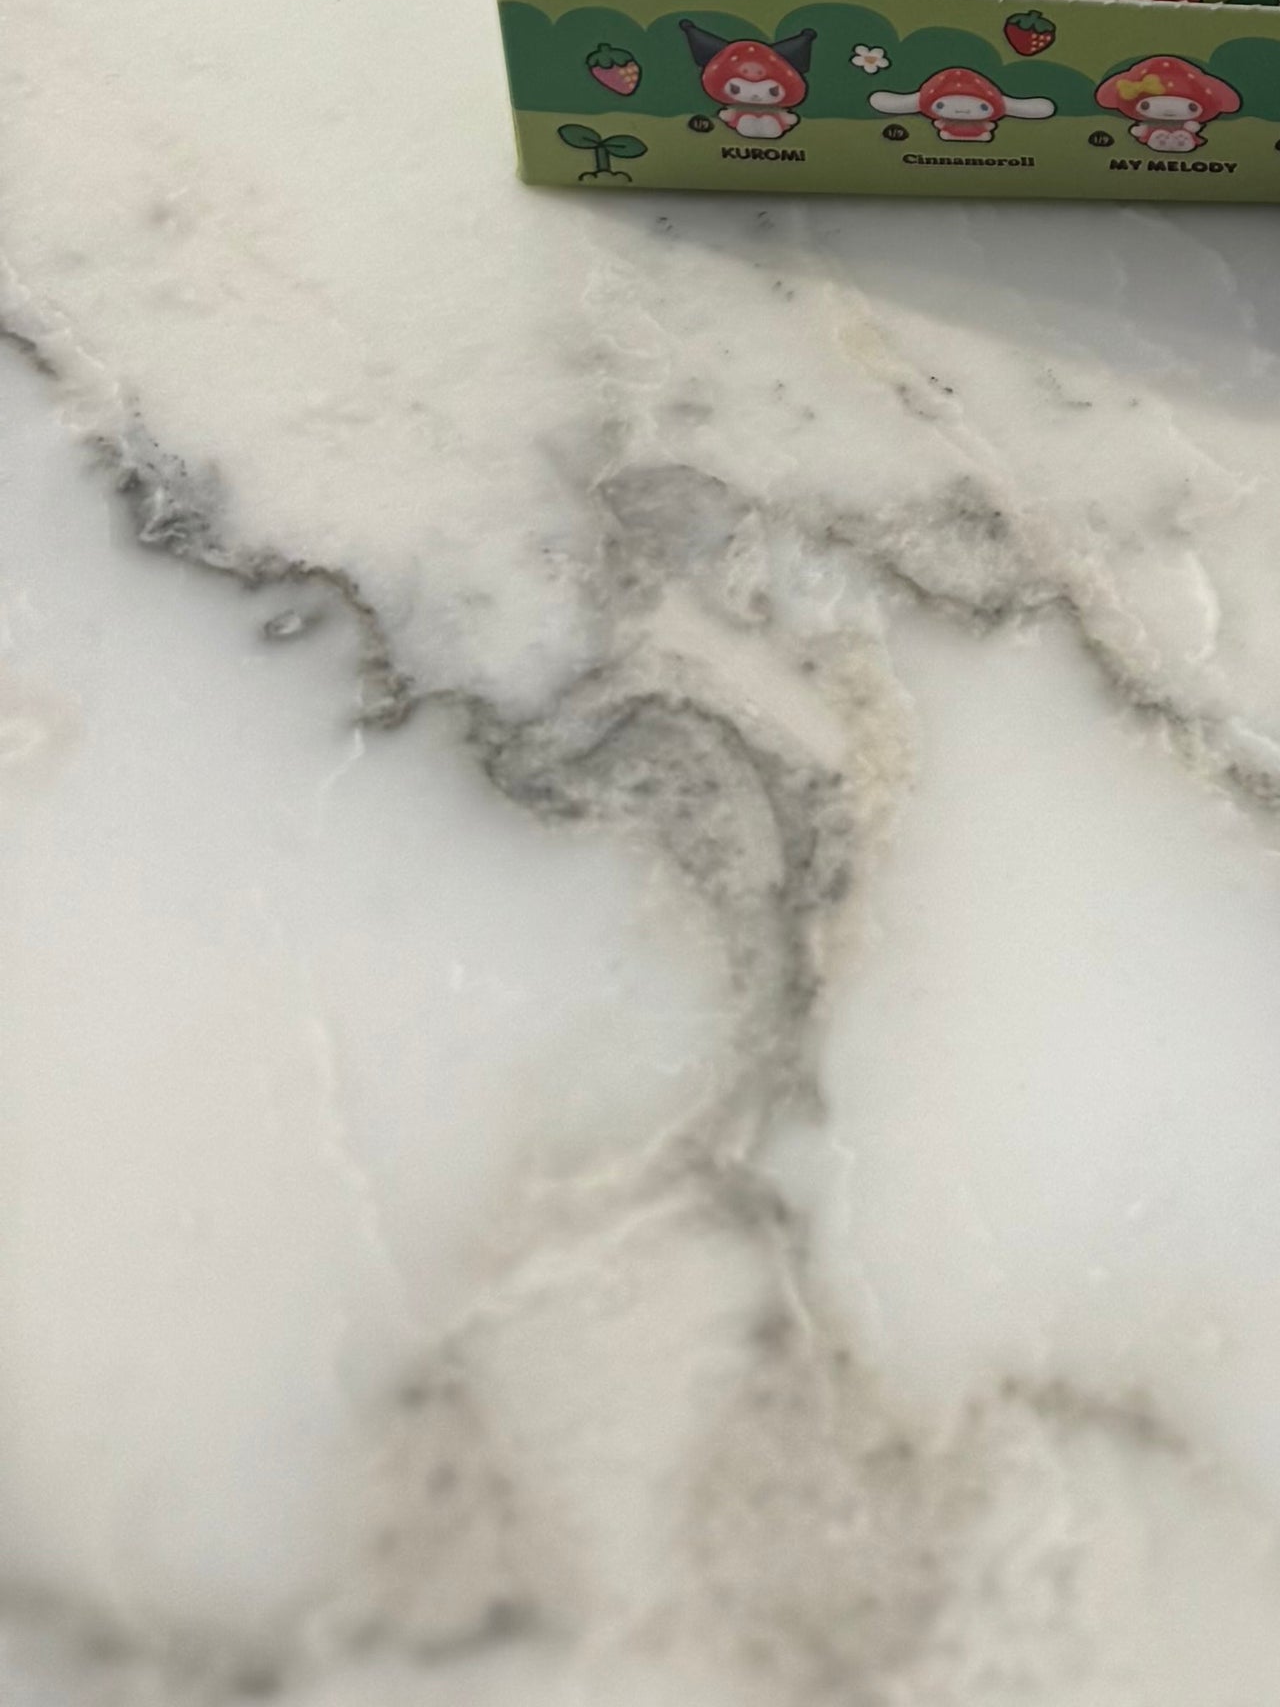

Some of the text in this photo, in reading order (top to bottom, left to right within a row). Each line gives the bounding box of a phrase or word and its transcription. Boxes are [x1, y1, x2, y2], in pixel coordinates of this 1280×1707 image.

[903, 153, 1035, 168] Cinnamoroll
[1109, 159, 1238, 174] MY MELODY
